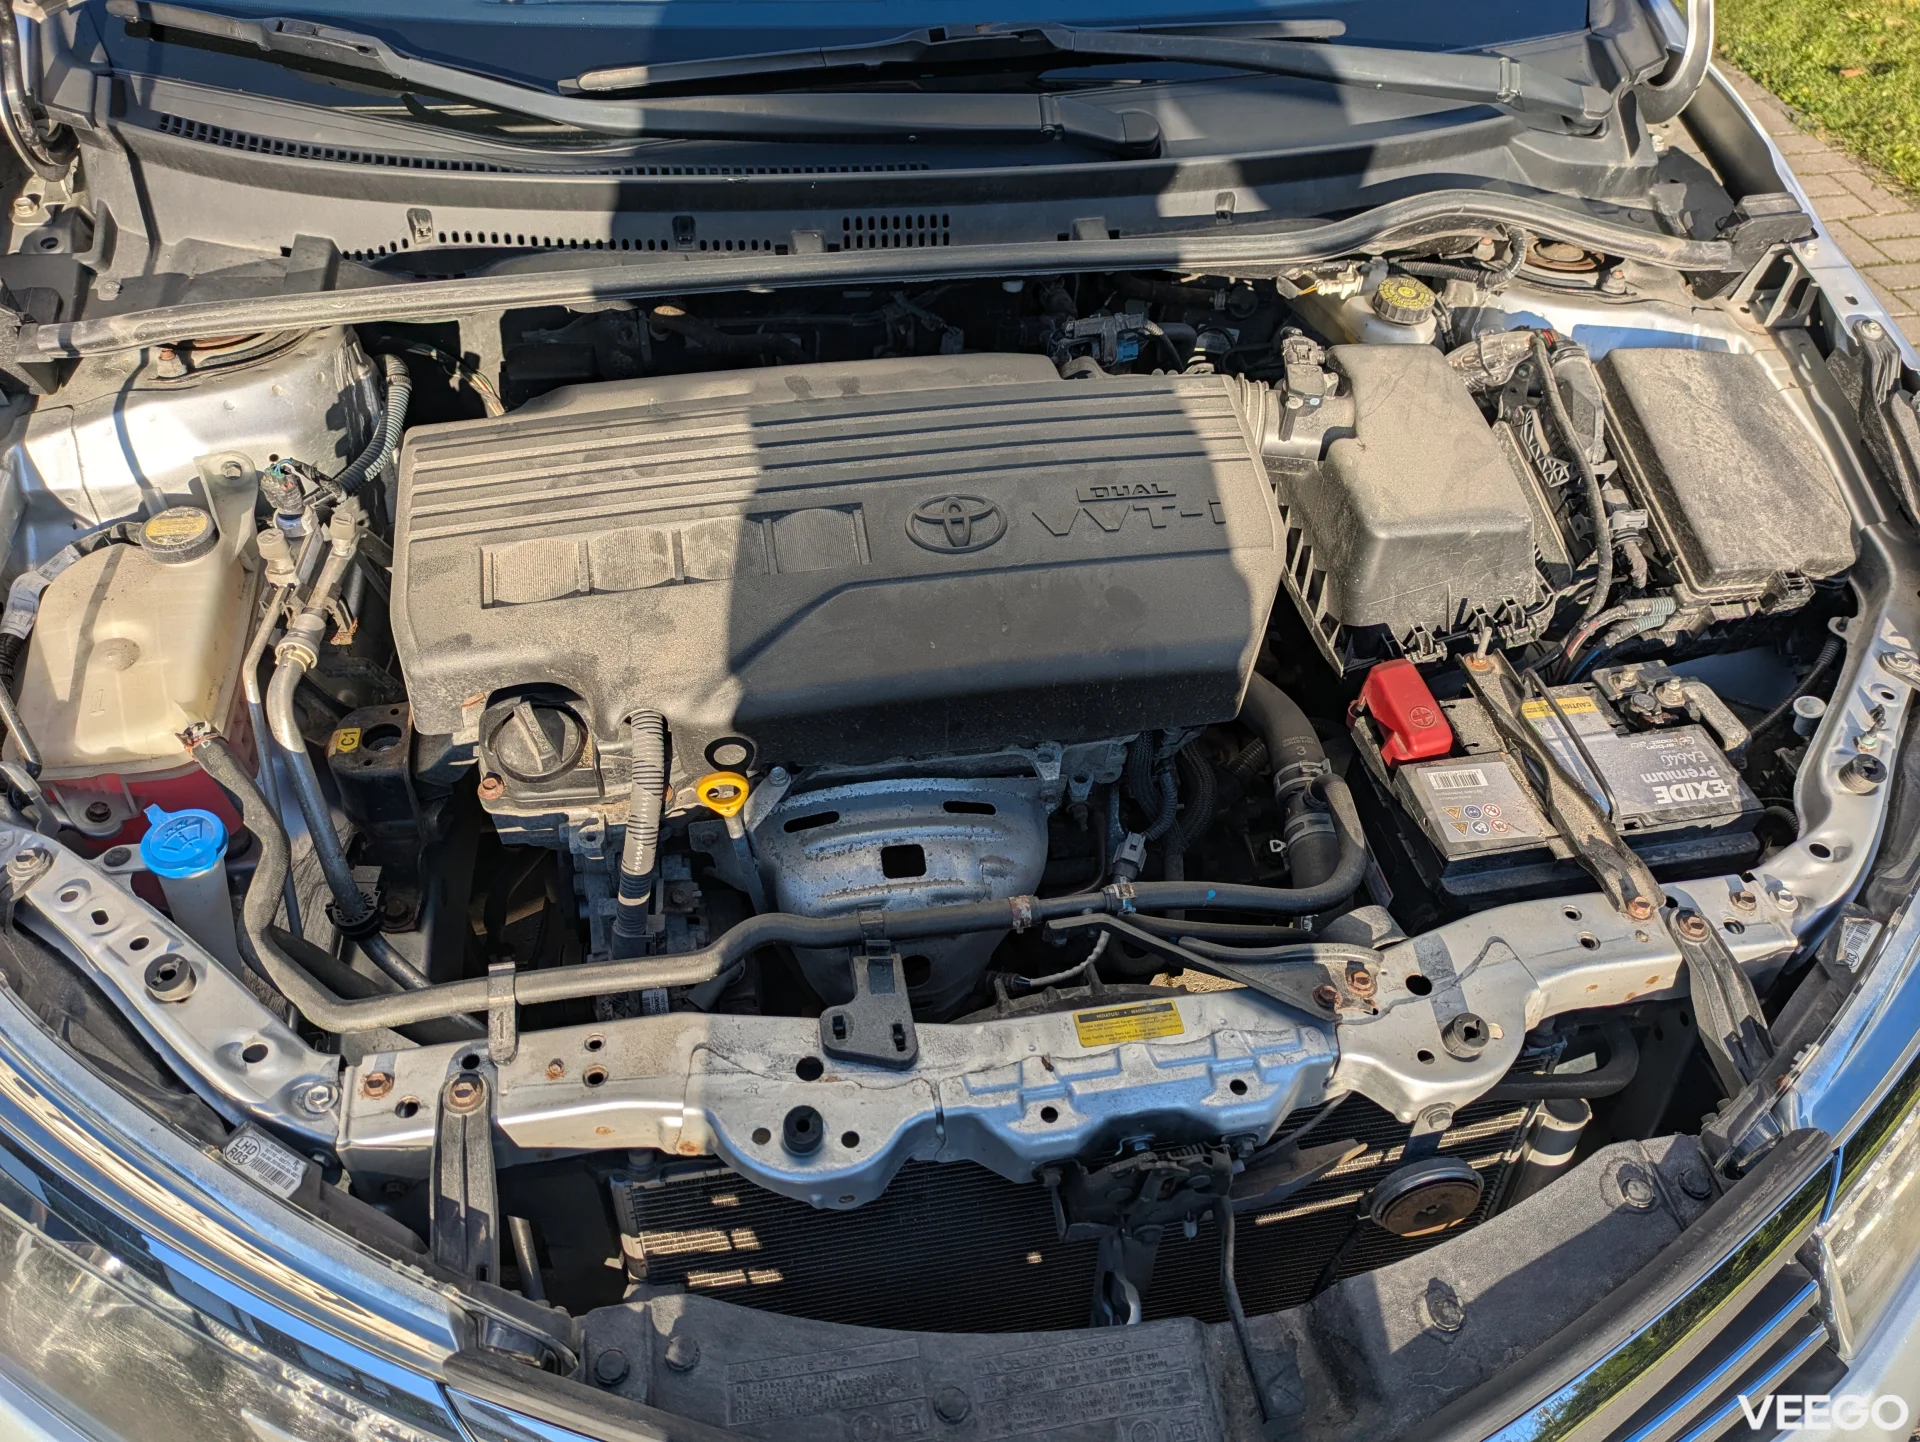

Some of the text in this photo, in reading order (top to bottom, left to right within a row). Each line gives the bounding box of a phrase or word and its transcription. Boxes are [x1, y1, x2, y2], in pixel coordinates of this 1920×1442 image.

[1089, 483, 1170, 498] DUAL
[341, 731, 357, 746] C1
[1661, 750, 1709, 767] EA640
[1640, 765, 1720, 784] Premium
[1652, 779, 1732, 805] EXIDE
[226, 1146, 249, 1164] R03
[234, 1137, 258, 1156] LHD
